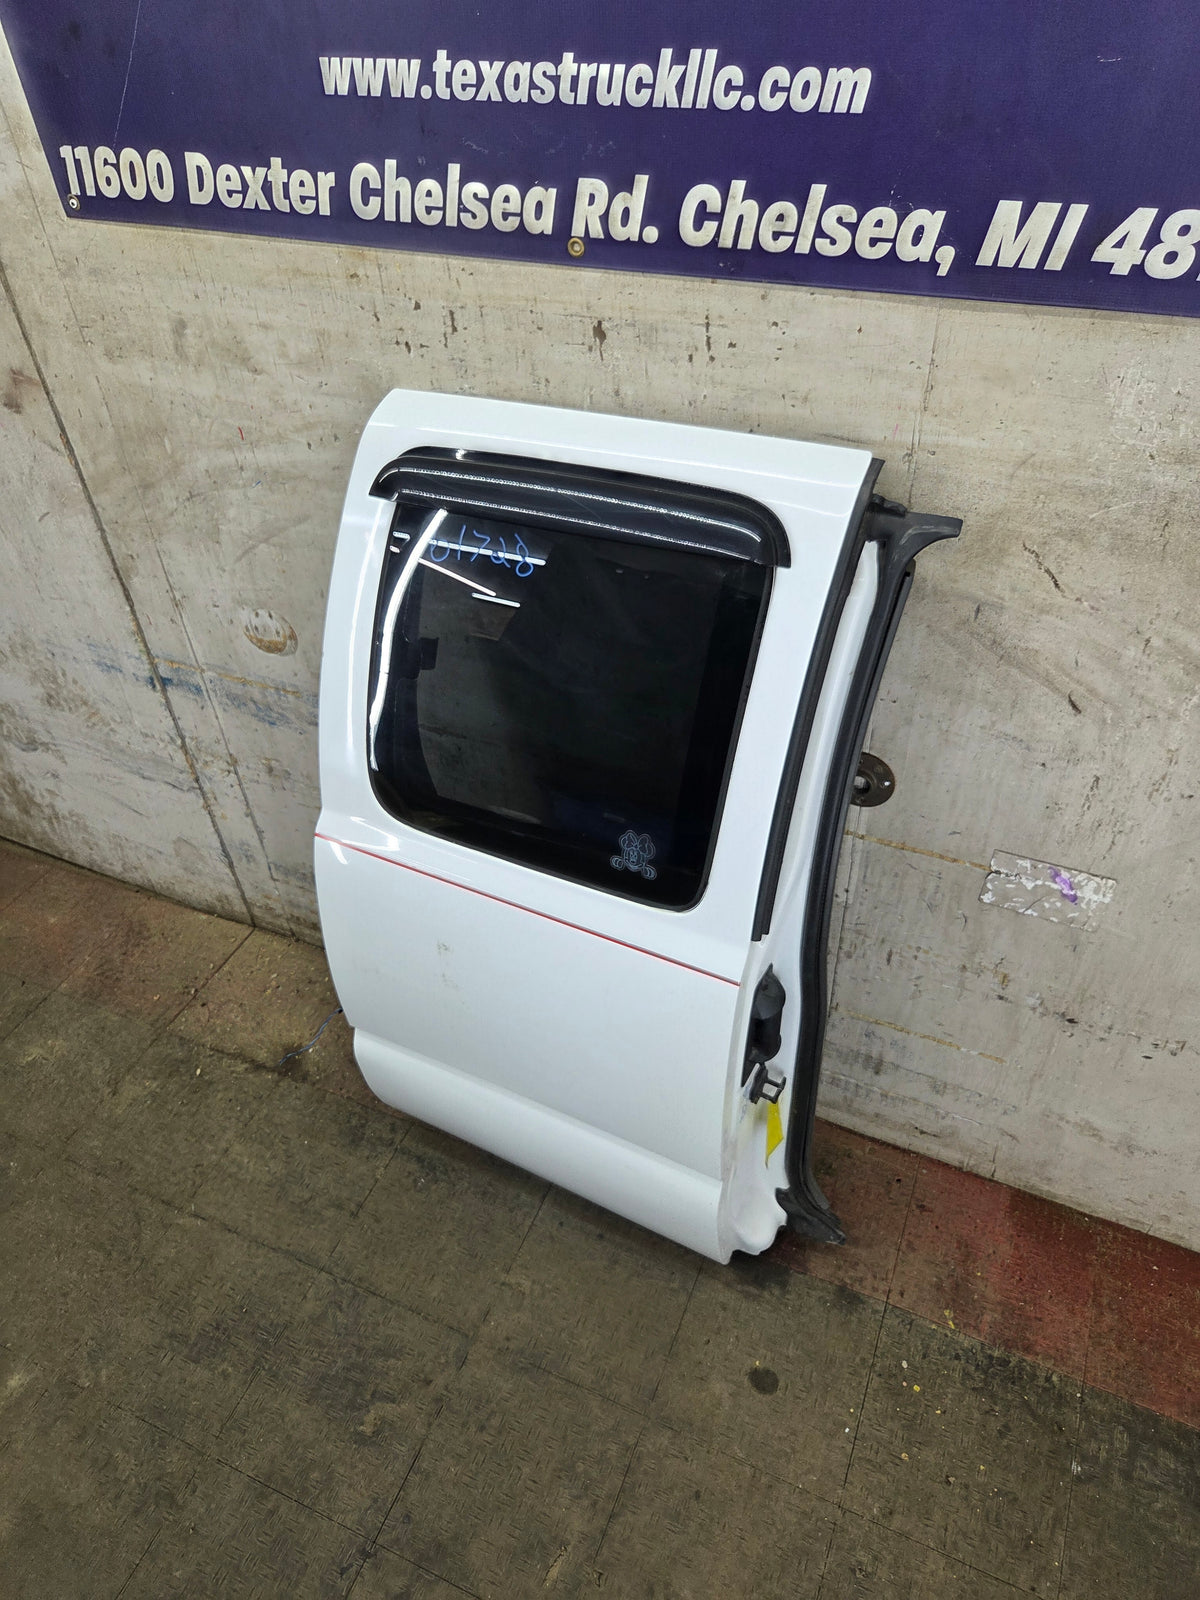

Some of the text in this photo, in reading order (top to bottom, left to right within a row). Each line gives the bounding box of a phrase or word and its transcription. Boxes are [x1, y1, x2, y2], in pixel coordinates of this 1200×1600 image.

[319, 48, 872, 113] www.texastruckllc.com
[60, 145, 1200, 281] 11600 Dexter Chelsea Rd. Chelsea, MI 48
